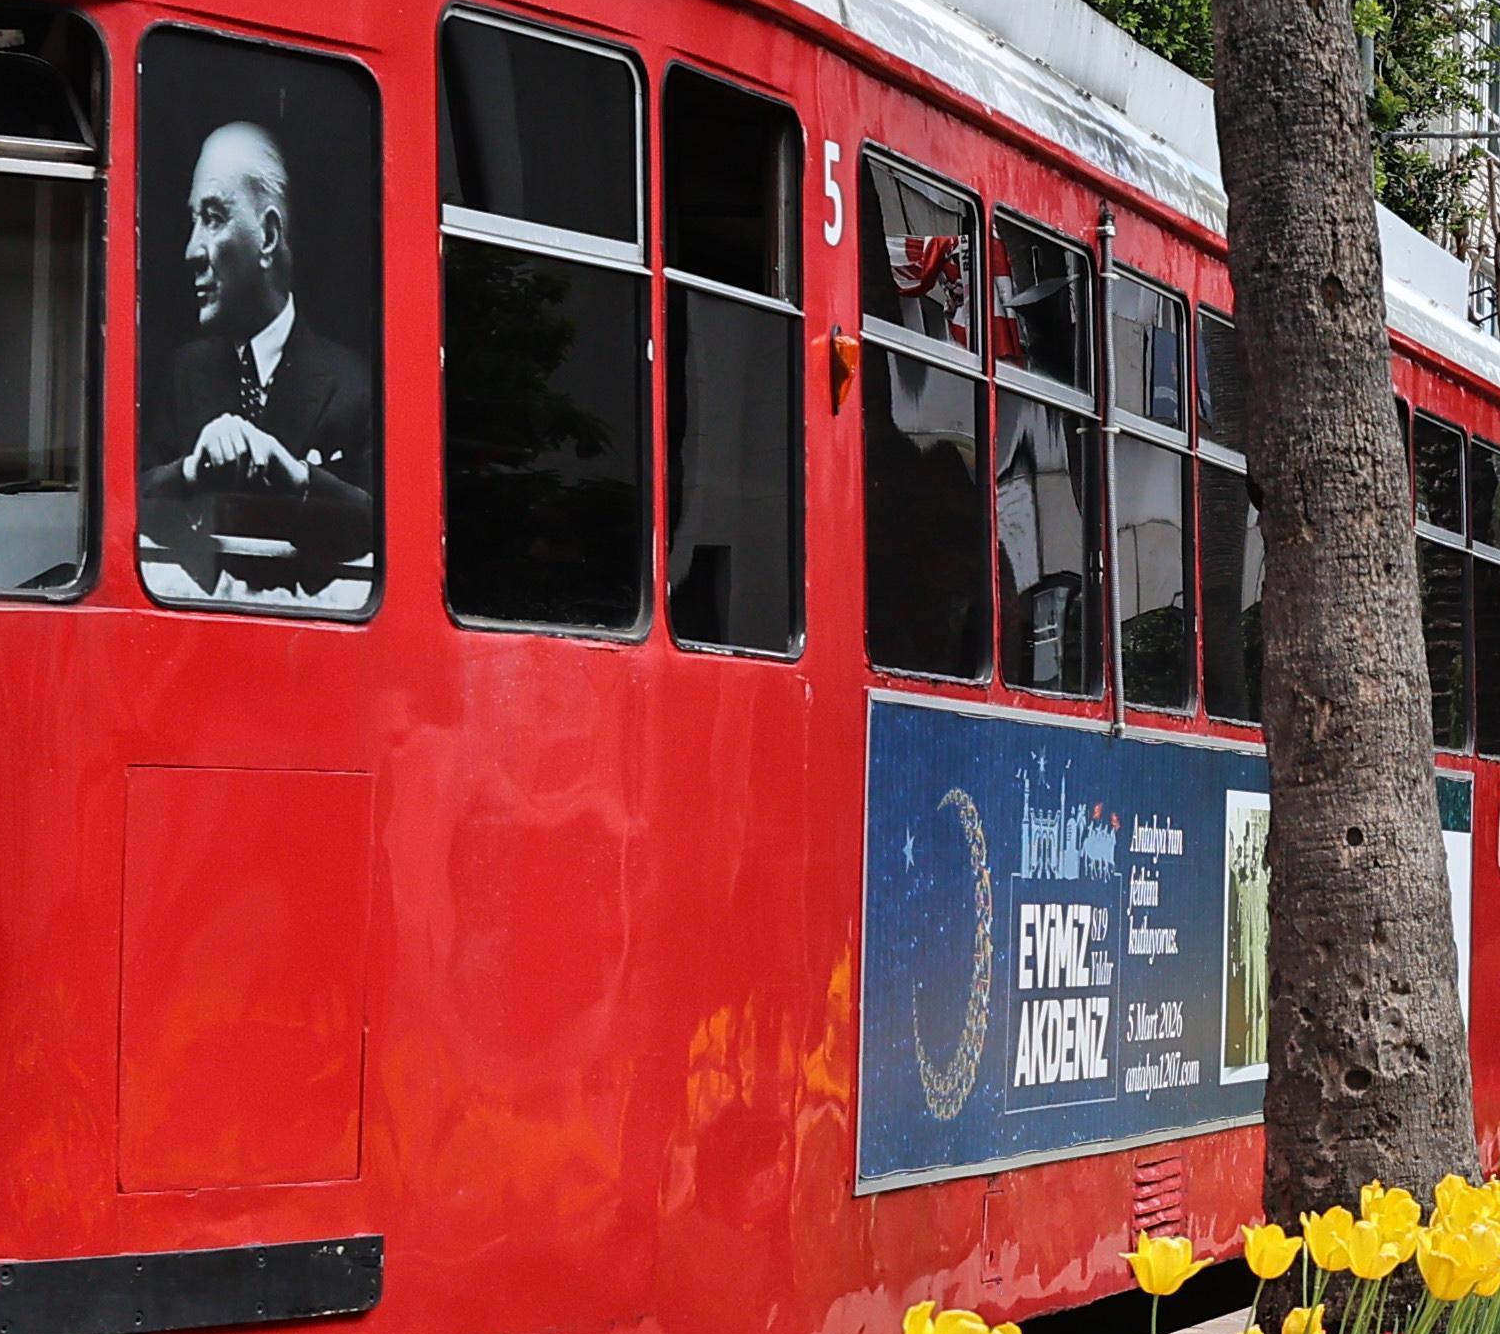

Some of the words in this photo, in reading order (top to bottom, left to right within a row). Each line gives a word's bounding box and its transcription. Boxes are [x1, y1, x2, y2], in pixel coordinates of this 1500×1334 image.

[823, 139, 844, 247] 5
[1127, 865, 1160, 915] fethini
[1019, 904, 1092, 990] EVİMİZ
[1090, 907, 1109, 943] 819
[1013, 996, 1110, 1089] AKDENİZ
[1126, 1004, 1135, 1042] 5
[1135, 1003, 1159, 1041] Mart
[1159, 1001, 1184, 1039] 2026
[1125, 1052, 1200, 1101] antalya1207.com
